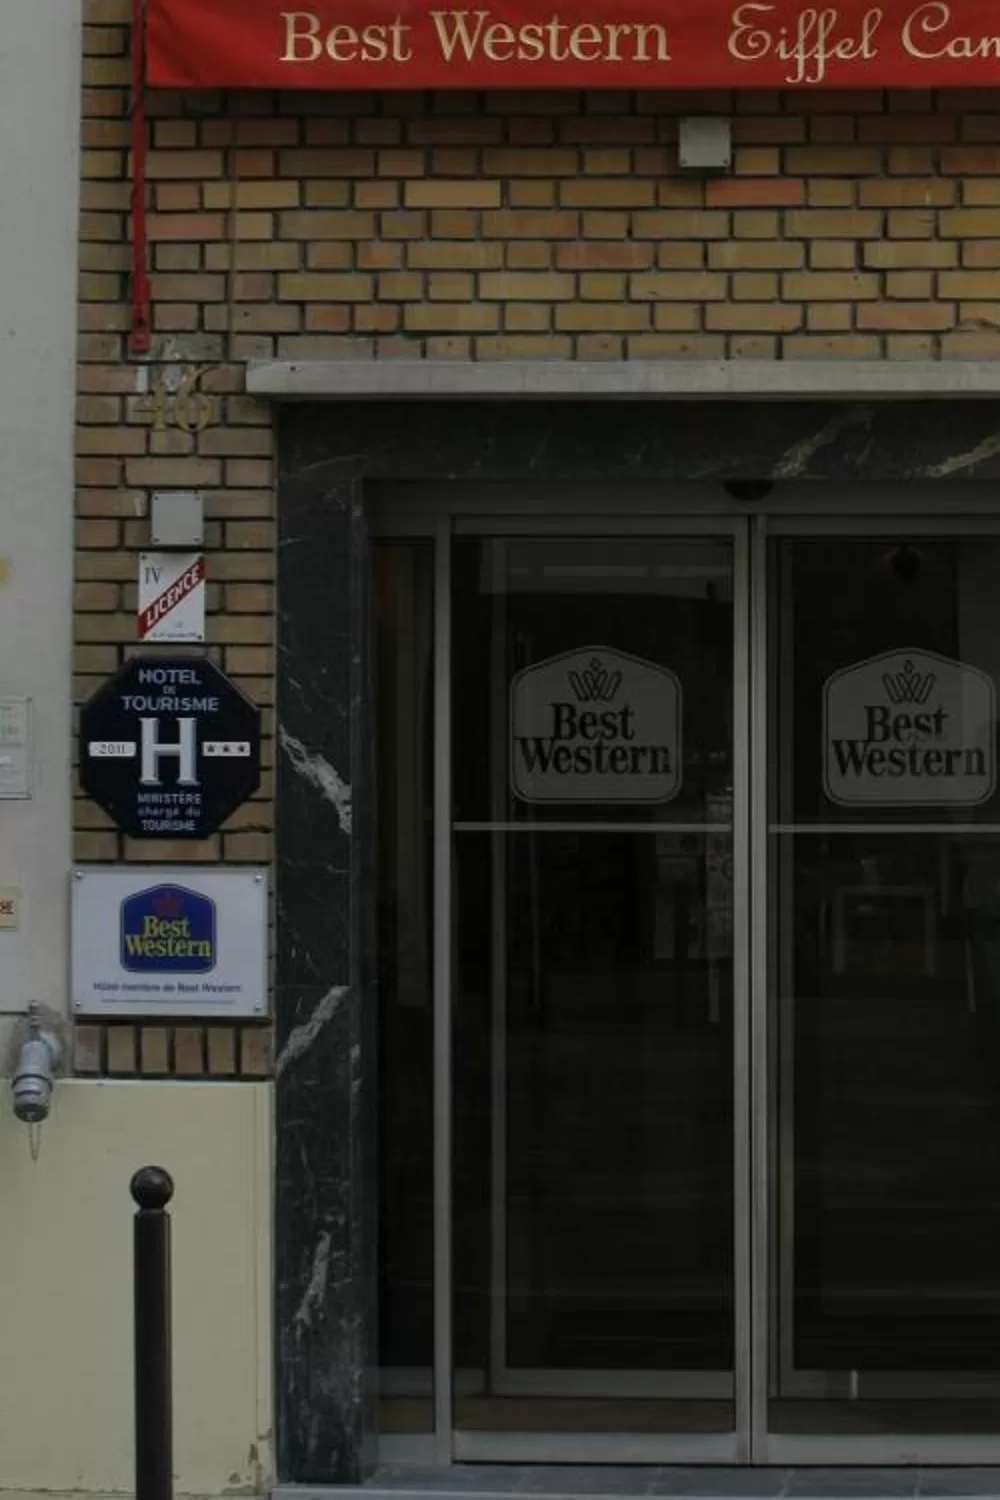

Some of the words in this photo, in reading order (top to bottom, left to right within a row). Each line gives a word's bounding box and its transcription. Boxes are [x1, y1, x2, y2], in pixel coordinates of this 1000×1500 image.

[278, 11, 413, 62] Best
[429, 9, 672, 62] Western
[727, 2, 883, 84] Eiffel
[144, 566, 163, 585] IV
[146, 563, 200, 627] LICENCE
[121, 696, 219, 712] TOURISME
[551, 702, 635, 741] Best
[863, 705, 949, 743] Best
[138, 717, 202, 786] H
[514, 736, 672, 775] Western
[831, 739, 988, 778] Western
[142, 819, 196, 831] TOURISME
[143, 915, 190, 938] Best
[125, 935, 212, 958] Western
